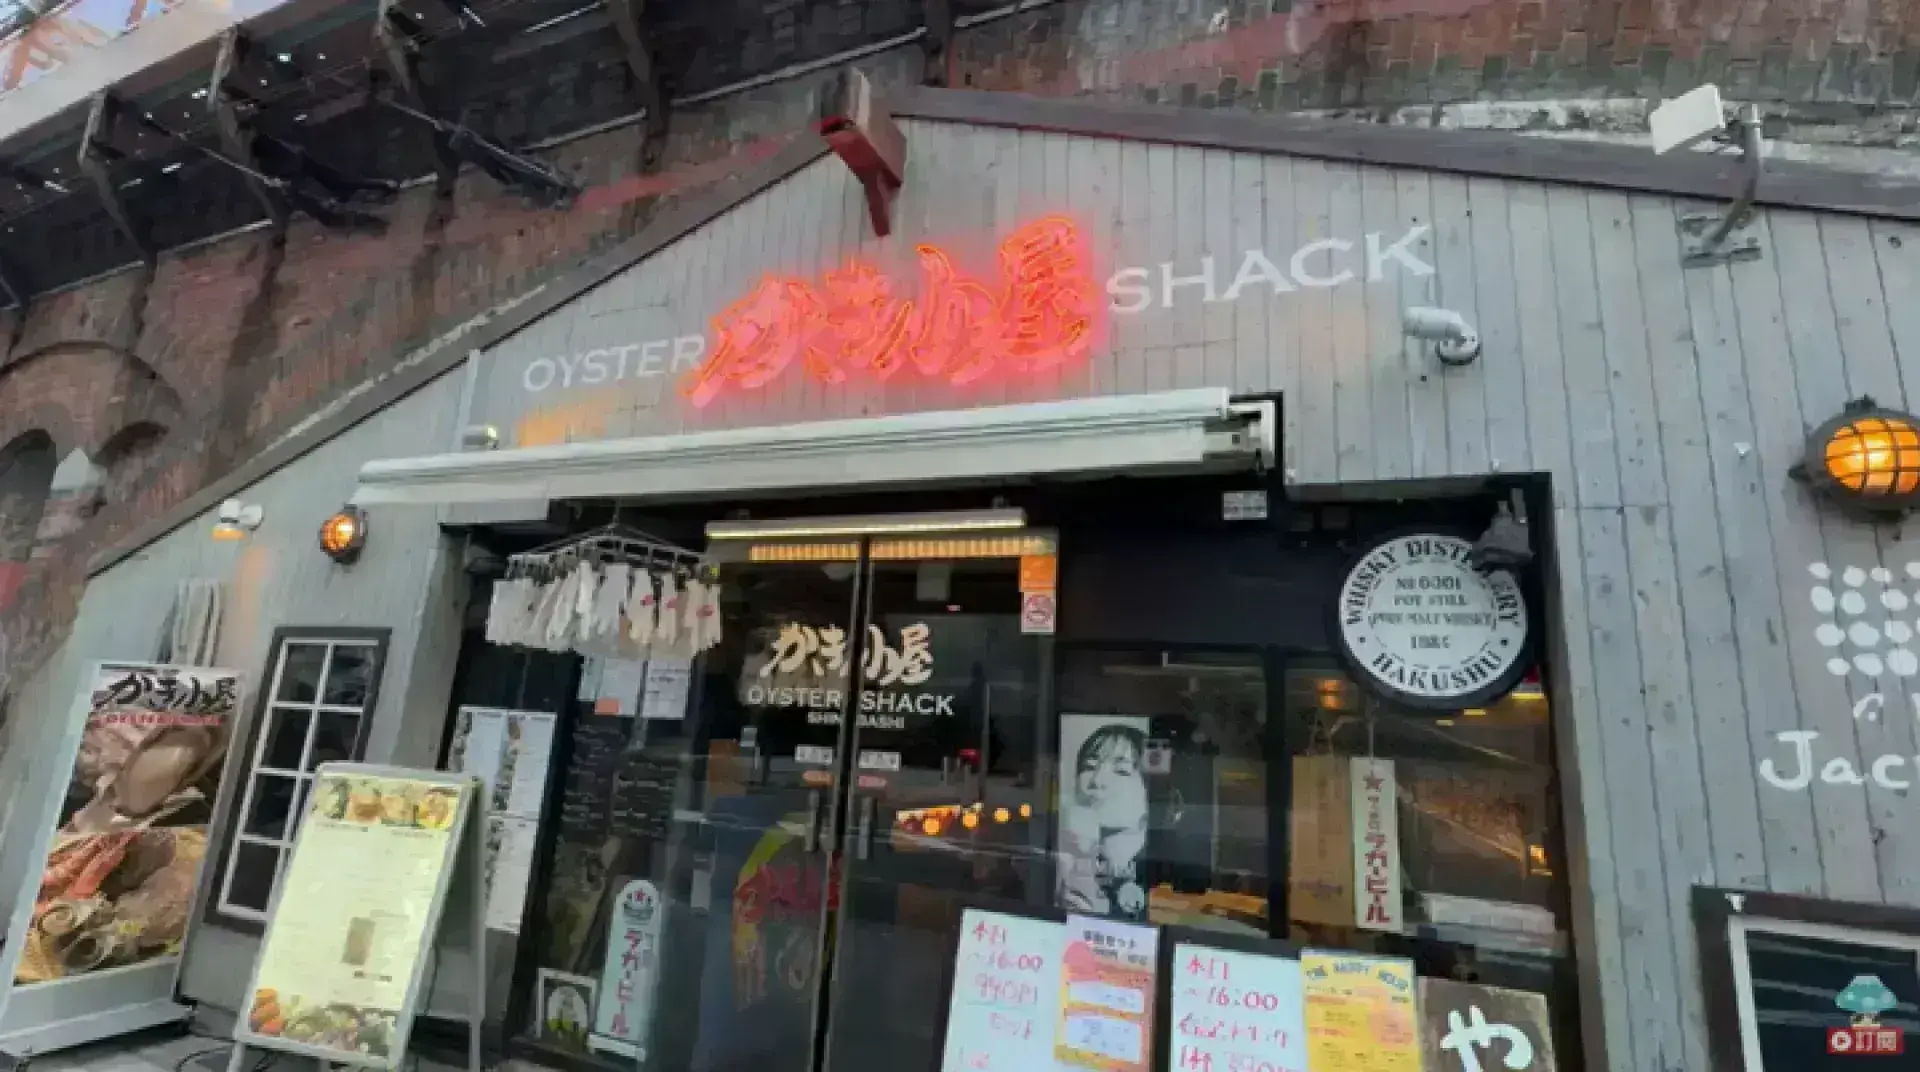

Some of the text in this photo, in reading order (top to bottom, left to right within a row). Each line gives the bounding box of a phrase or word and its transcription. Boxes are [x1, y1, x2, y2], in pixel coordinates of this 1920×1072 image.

[1106, 223, 1436, 314] SHACK
[523, 334, 705, 392] OYSTER
[1346, 545, 1396, 625] WHISKY
[1372, 651, 1501, 689] HAKUSHU
[748, 686, 955, 716] OYSTER SHACK
[1760, 730, 1920, 792] Jac
